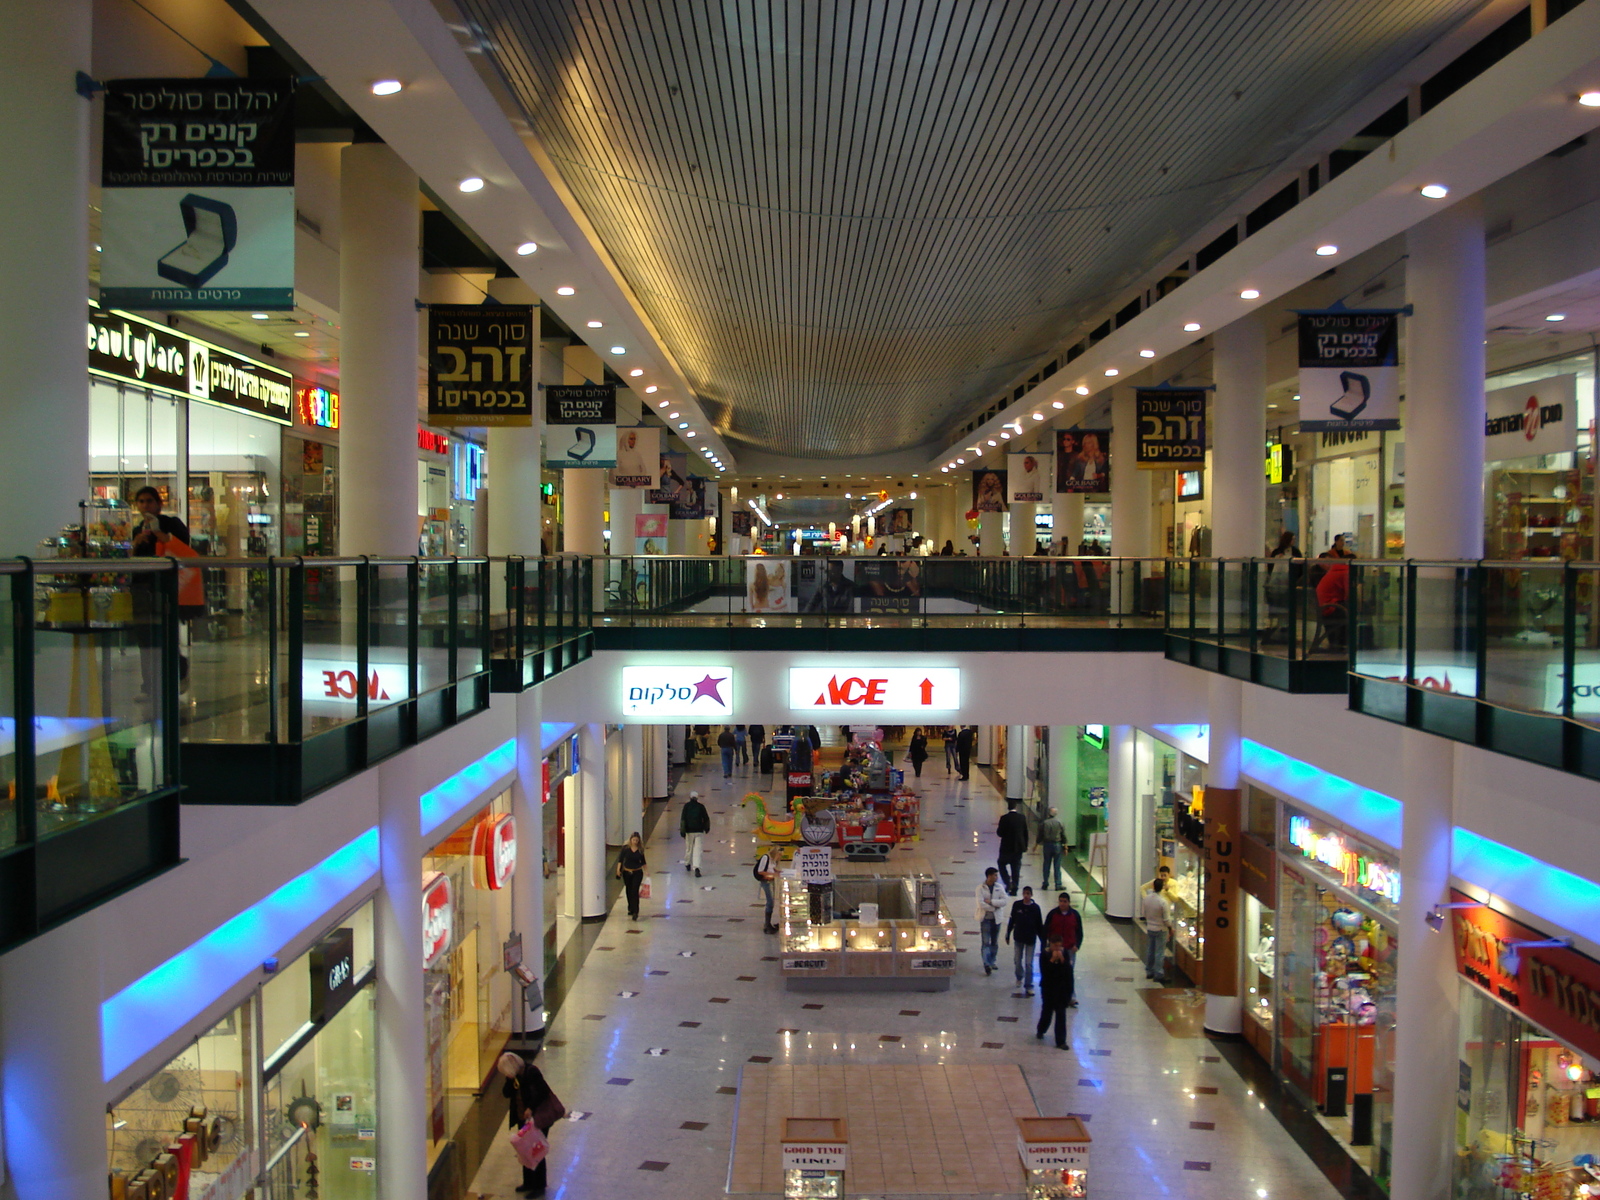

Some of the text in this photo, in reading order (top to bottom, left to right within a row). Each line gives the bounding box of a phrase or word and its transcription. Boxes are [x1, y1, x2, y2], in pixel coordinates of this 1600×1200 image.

[123, 87, 278, 110] יהלום סוליטר
[140, 123, 257, 148] קונים רק
[151, 289, 241, 300] פרטים בחנות
[1308, 315, 1389, 327] יהלום סוליטר
[437, 323, 525, 346] סוף שנה
[1317, 333, 1379, 347] קונים רק
[437, 346, 526, 382] זהב
[553, 388, 610, 398] יהלום סוליטר
[560, 401, 603, 411] קונים רק
[1142, 400, 1202, 416] סוף שנה
[1142, 415, 1202, 440] זהב
[306, 517, 319, 546] FIFA
[629, 683, 692, 705] סלקום
[814, 674, 889, 705] ACE
[801, 860, 829, 868] מוכרת
[802, 868, 830, 877] מנוסה
[1061, 1146, 1088, 1154] TIME
